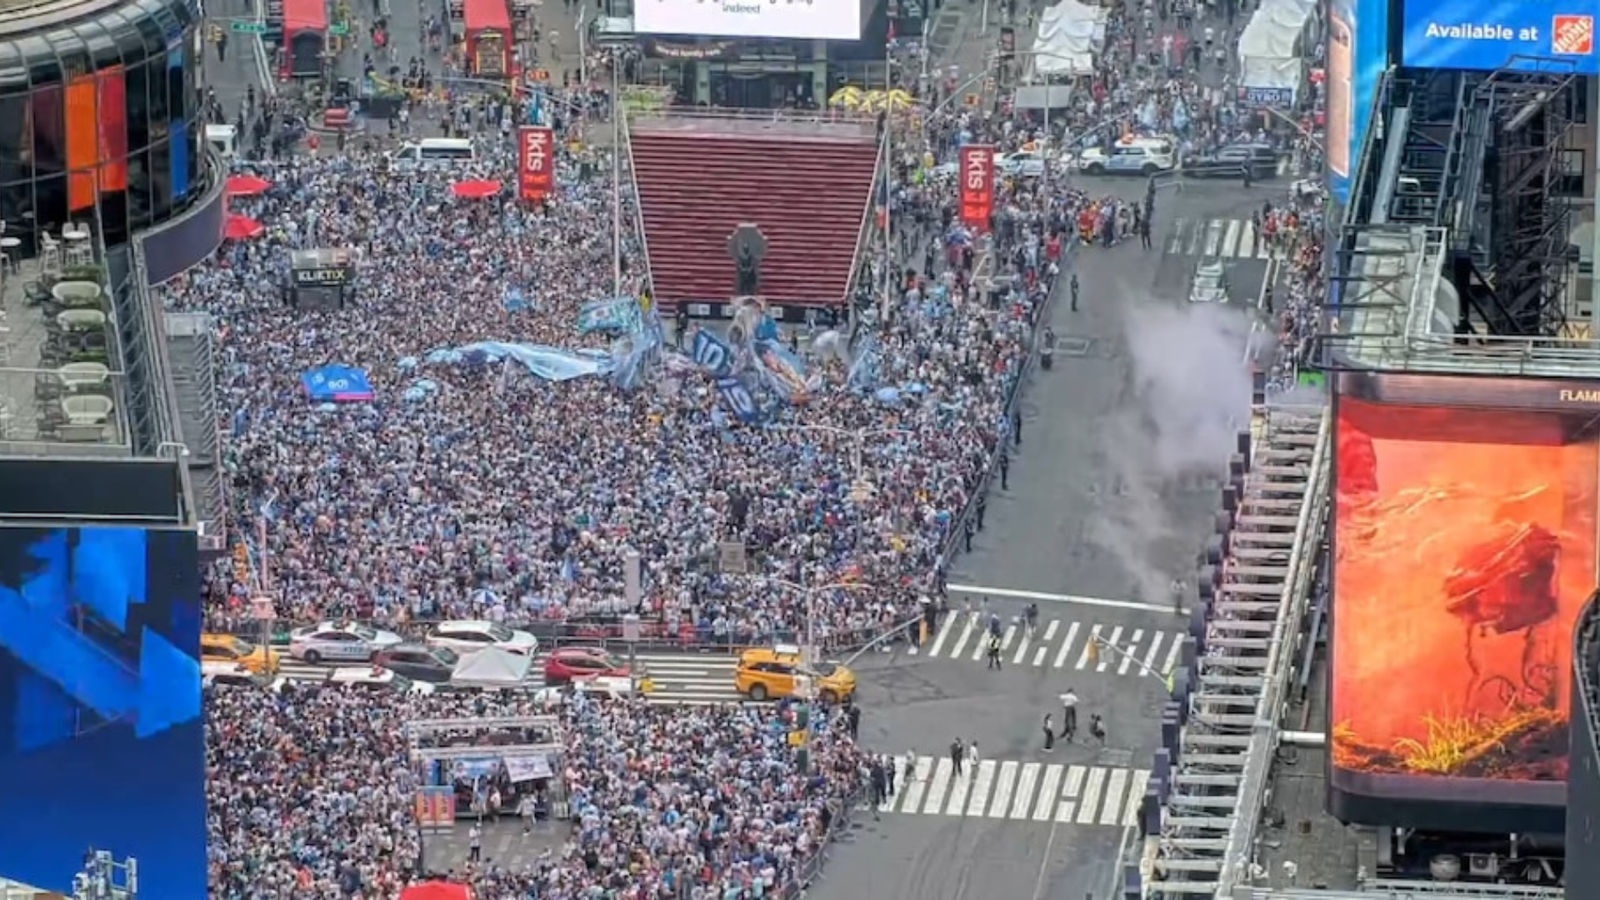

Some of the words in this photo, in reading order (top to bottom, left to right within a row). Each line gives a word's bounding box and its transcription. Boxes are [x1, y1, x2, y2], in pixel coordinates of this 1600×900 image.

[722, 4, 760, 14] indeed
[1425, 22, 1513, 40] Available
[1519, 27, 1539, 41] at
[527, 132, 547, 171] tkts
[968, 150, 988, 189] tkts
[1560, 389, 1600, 403] FLAM
